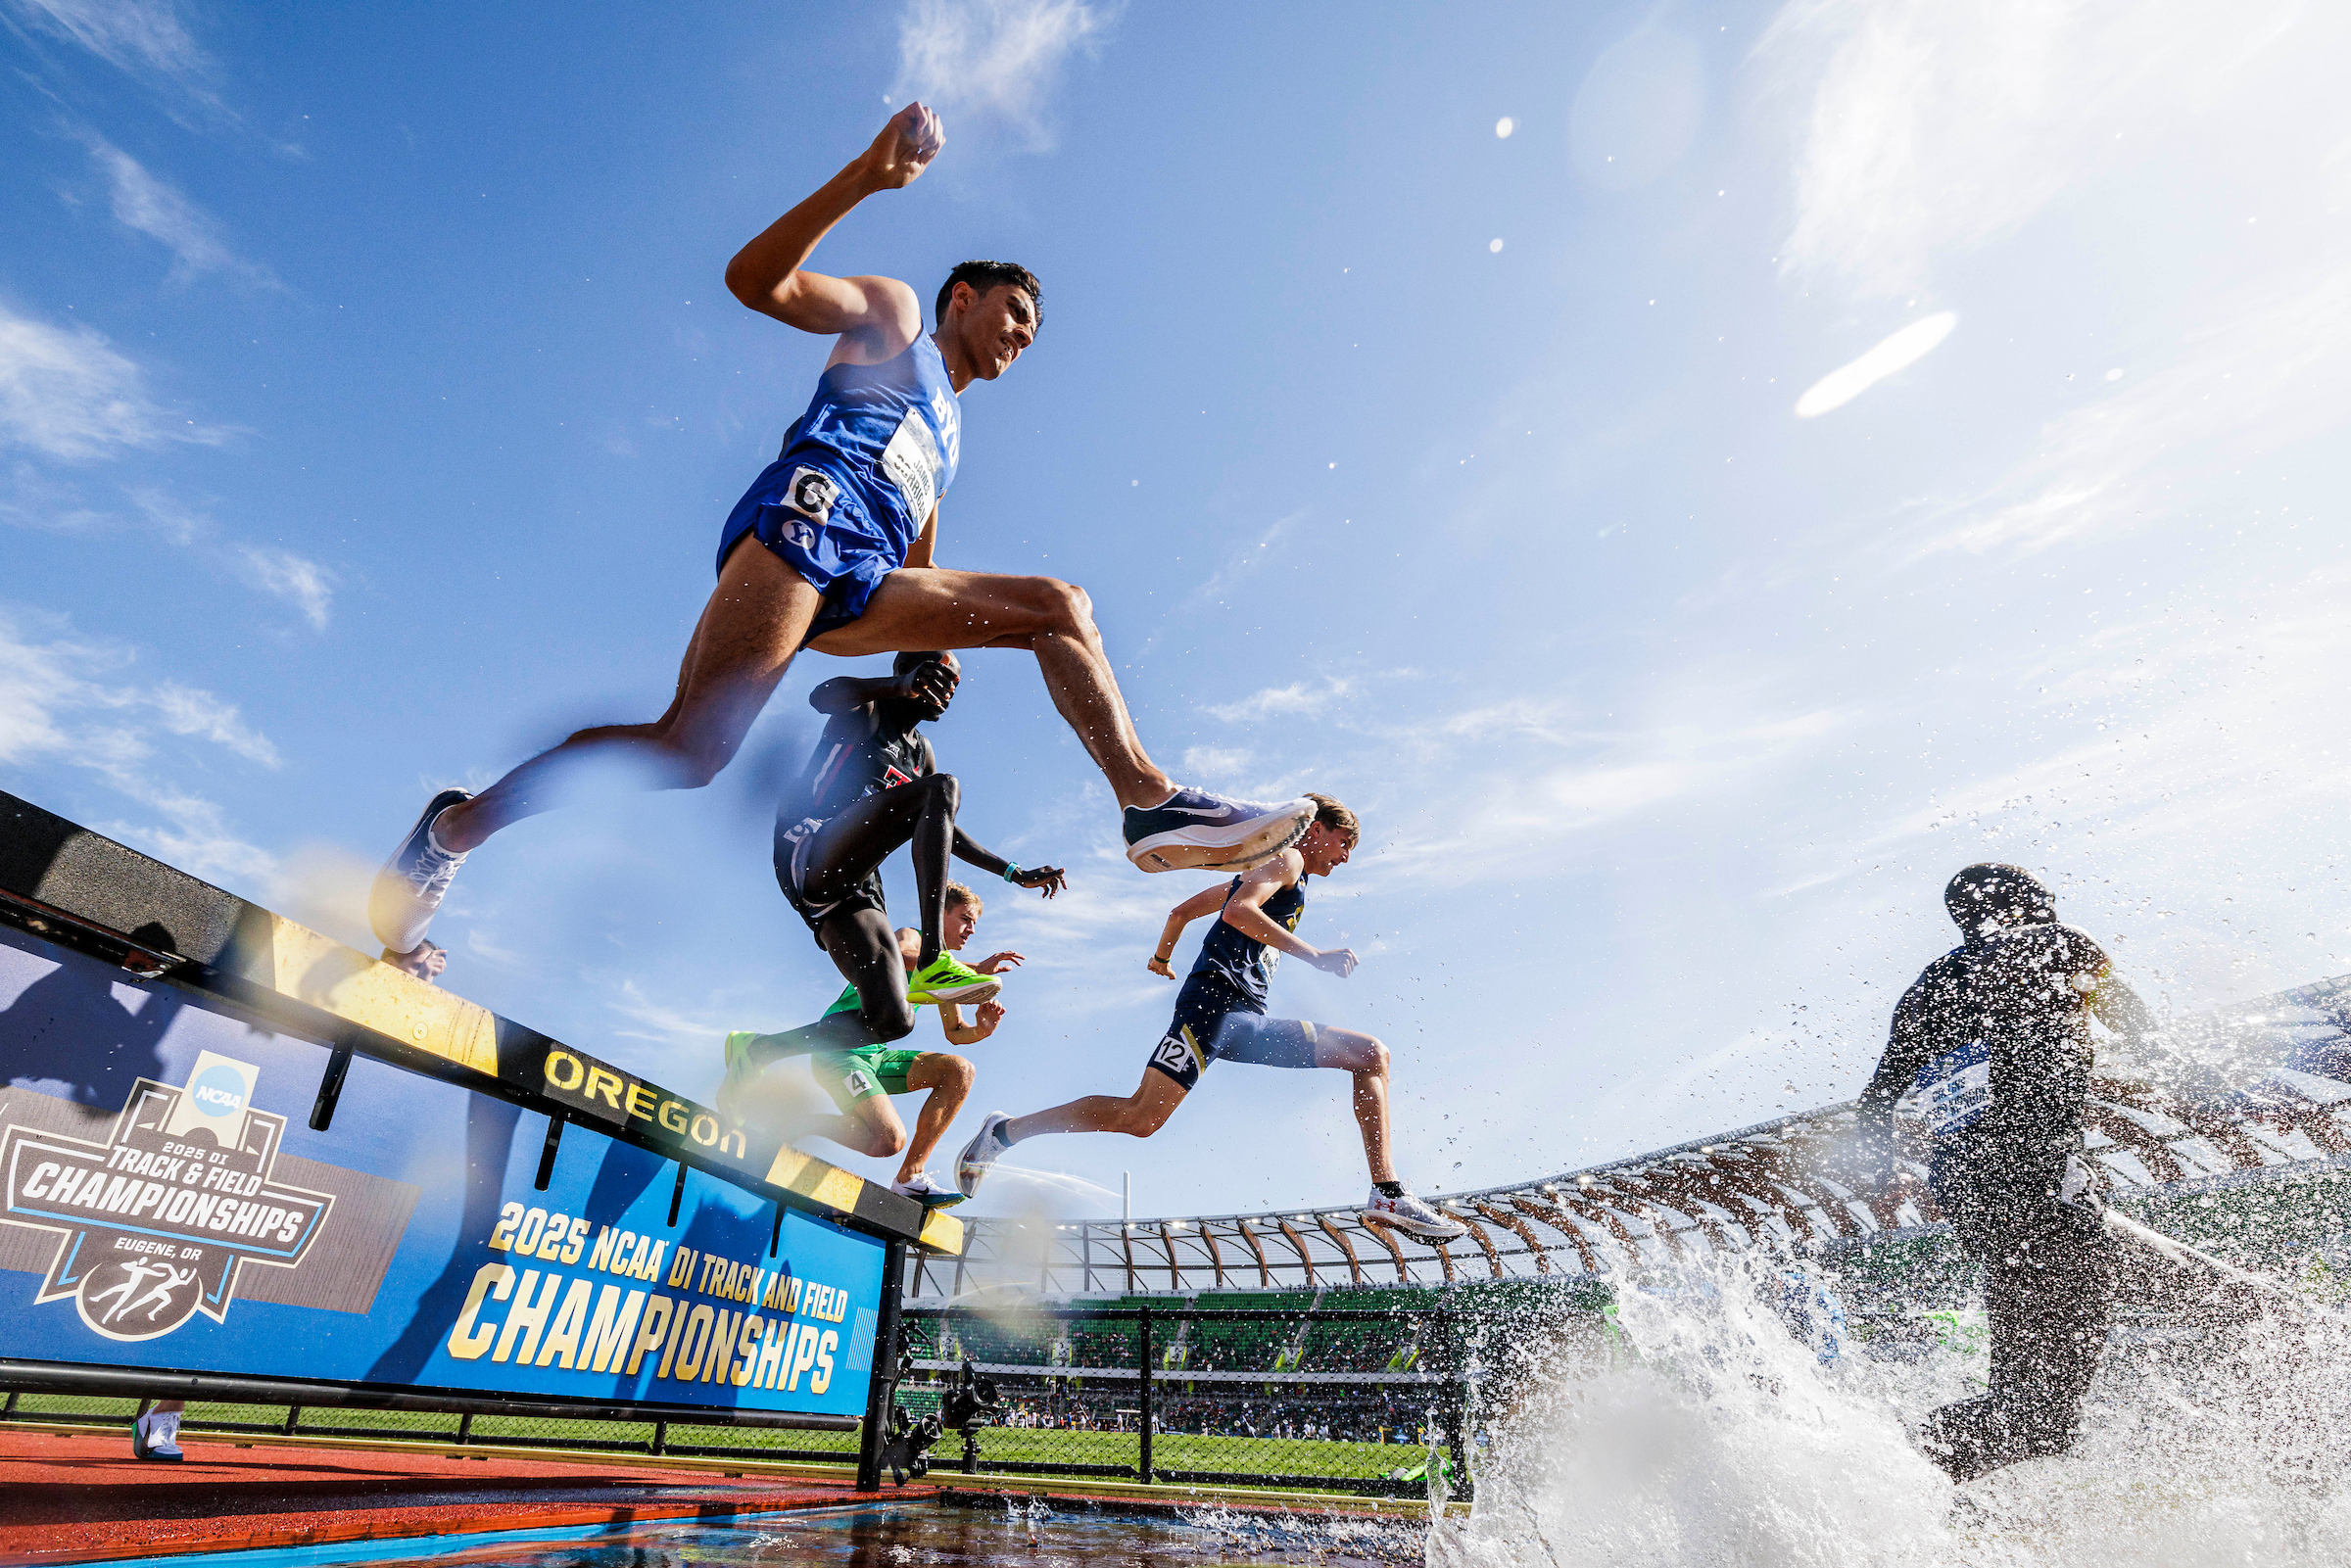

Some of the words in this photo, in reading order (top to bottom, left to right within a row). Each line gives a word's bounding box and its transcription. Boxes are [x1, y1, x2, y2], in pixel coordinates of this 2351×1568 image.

[931, 386, 959, 468] BYU
[914, 460, 931, 496] JAMES
[1160, 1040, 1185, 1068] 12
[195, 1085, 242, 1109] NCAA
[851, 1072, 867, 1091] 4
[108, 1145, 187, 1182] TRACK
[182, 1162, 205, 1185] &
[201, 1165, 263, 1197] FIELD
[162, 1141, 207, 1160] 2025
[208, 1152, 230, 1165] DI
[22, 1162, 305, 1243] CHAMPIONSHIPS
[115, 1237, 176, 1259] EUGENE,
[177, 1246, 203, 1261] OR
[488, 1202, 592, 1265] 2025
[590, 1225, 665, 1284] NCAA
[667, 1246, 697, 1290] DI
[696, 1253, 766, 1306] TRACK
[761, 1271, 801, 1314] AND
[801, 1280, 849, 1324] FIELD
[446, 1262, 840, 1396] CHAMPIONSHIPS
